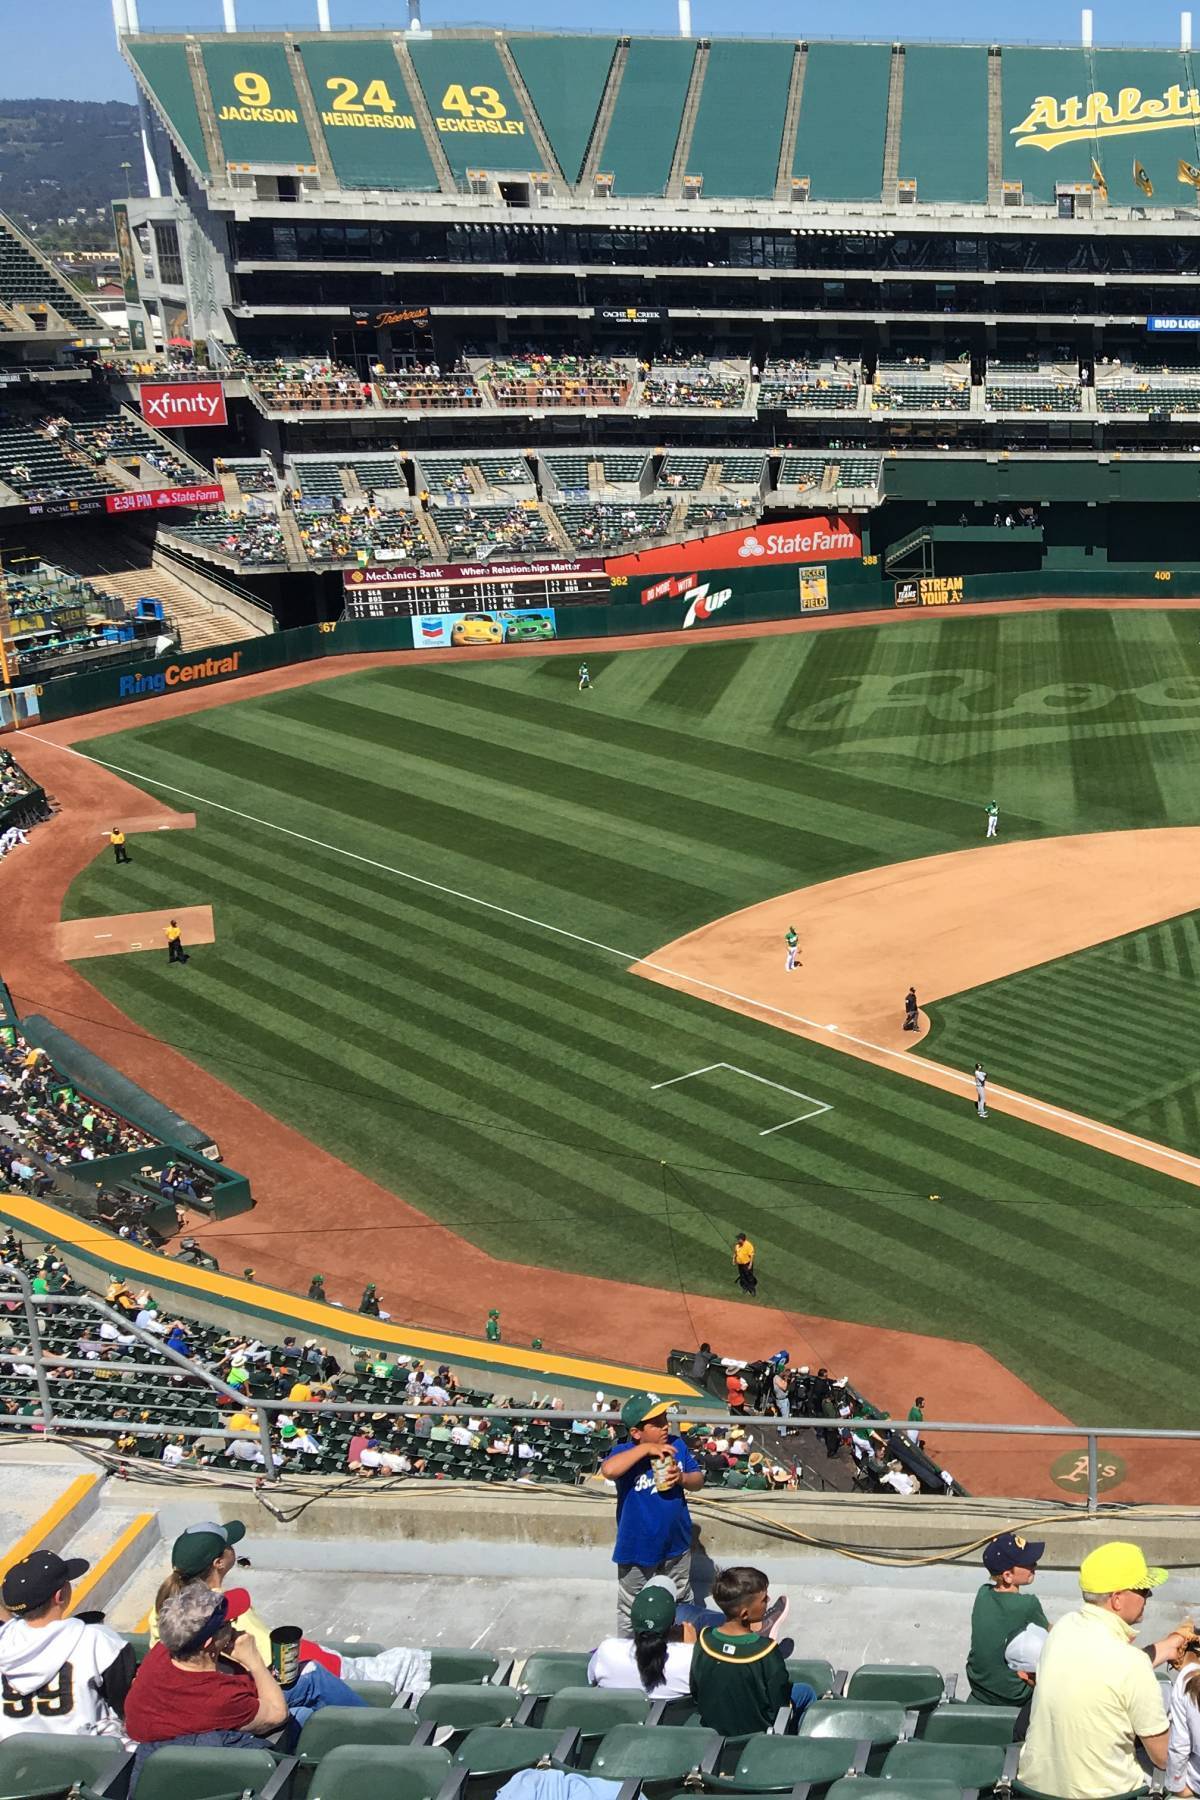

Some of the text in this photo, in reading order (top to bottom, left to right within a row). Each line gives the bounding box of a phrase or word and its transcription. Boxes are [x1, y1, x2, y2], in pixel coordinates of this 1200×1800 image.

[233, 72, 271, 106] 9
[326, 78, 396, 113] 24
[441, 84, 507, 120] 43
[218, 105, 298, 124] JACKSON
[322, 111, 416, 130] HENDERSON
[436, 117, 525, 135] ECKERSLEY
[1154, 319, 1178, 329] BUD
[147, 392, 220, 418] xfinity
[113, 492, 152, 510] 2:34 PM
[366, 570, 417, 581] Mechanics
[420, 569, 443, 578] Bank
[551, 563, 581, 572] Matter
[802, 569, 825, 577] RICKEY
[1154, 570, 1171, 580] 400
[610, 576, 628, 587] 362
[655, 581, 671, 599] MORE
[677, 575, 693, 591] WITH
[920, 577, 963, 592] STREAM
[802, 598, 827, 608] FIELD
[897, 590, 917, 600] TEAMS
[921, 592, 949, 605] YOUR
[119, 651, 240, 698] RingCentral
[1056, 1455, 1117, 1482] A's
